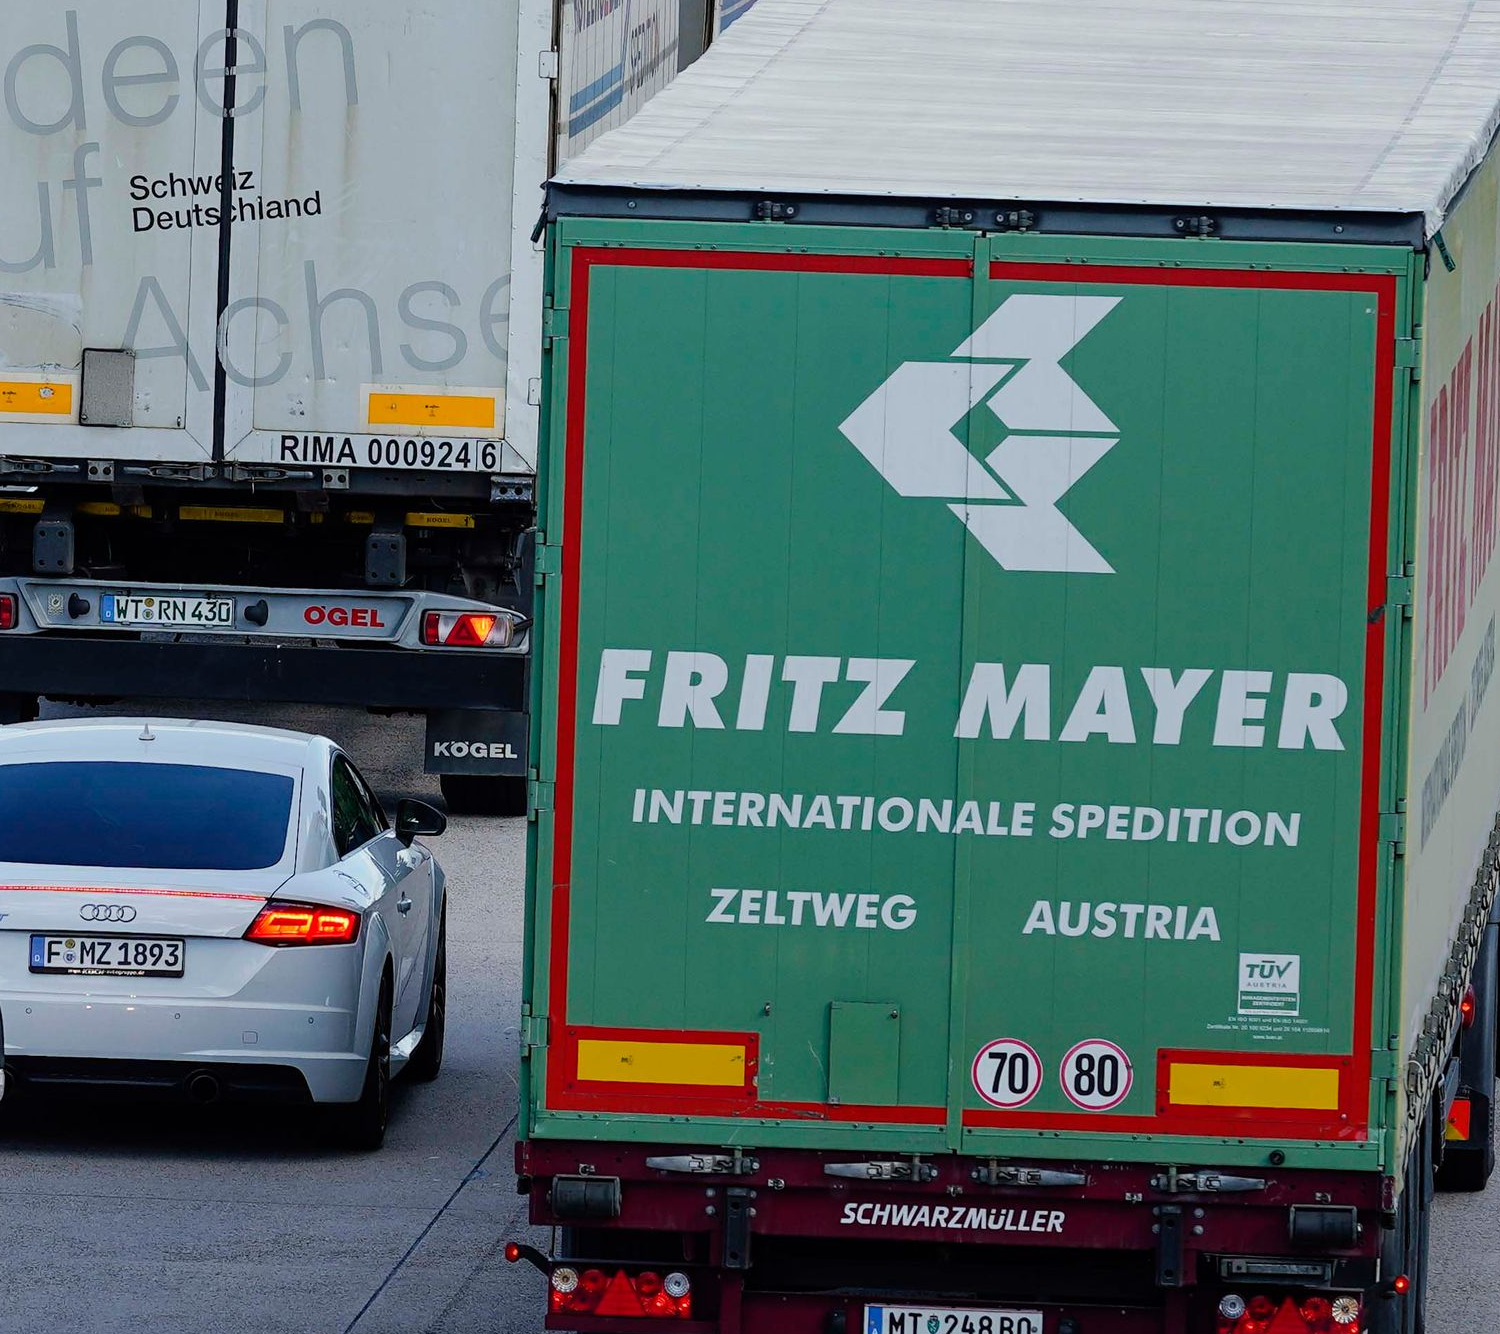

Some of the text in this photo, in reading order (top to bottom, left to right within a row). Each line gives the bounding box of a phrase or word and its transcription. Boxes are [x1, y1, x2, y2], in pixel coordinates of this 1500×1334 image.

[129, 166, 256, 201] Schweiz
[132, 190, 322, 233] Deutschland
[280, 435, 497, 469] RIMA 000924 6
[115, 595, 142, 620] WT
[157, 597, 188, 623] RN
[191, 598, 231, 624] 430
[592, 647, 917, 736] FRITZ
[953, 660, 1349, 752] MAYER
[434, 740, 519, 760] KÖGEL
[631, 787, 1301, 848] INTERNATIONALE SPEDITION
[705, 887, 918, 931] ZELTWEG
[1021, 899, 1222, 942] AUSTRIA
[47, 940, 63, 965] F
[79, 942, 112, 966] MZ
[117, 943, 180, 968] 1893
[1246, 959, 1294, 980] TÜV
[987, 1051, 1030, 1096] 70
[1073, 1053, 1120, 1097] 80
[840, 1202, 1066, 1233] SCHWARZMÜLLER
